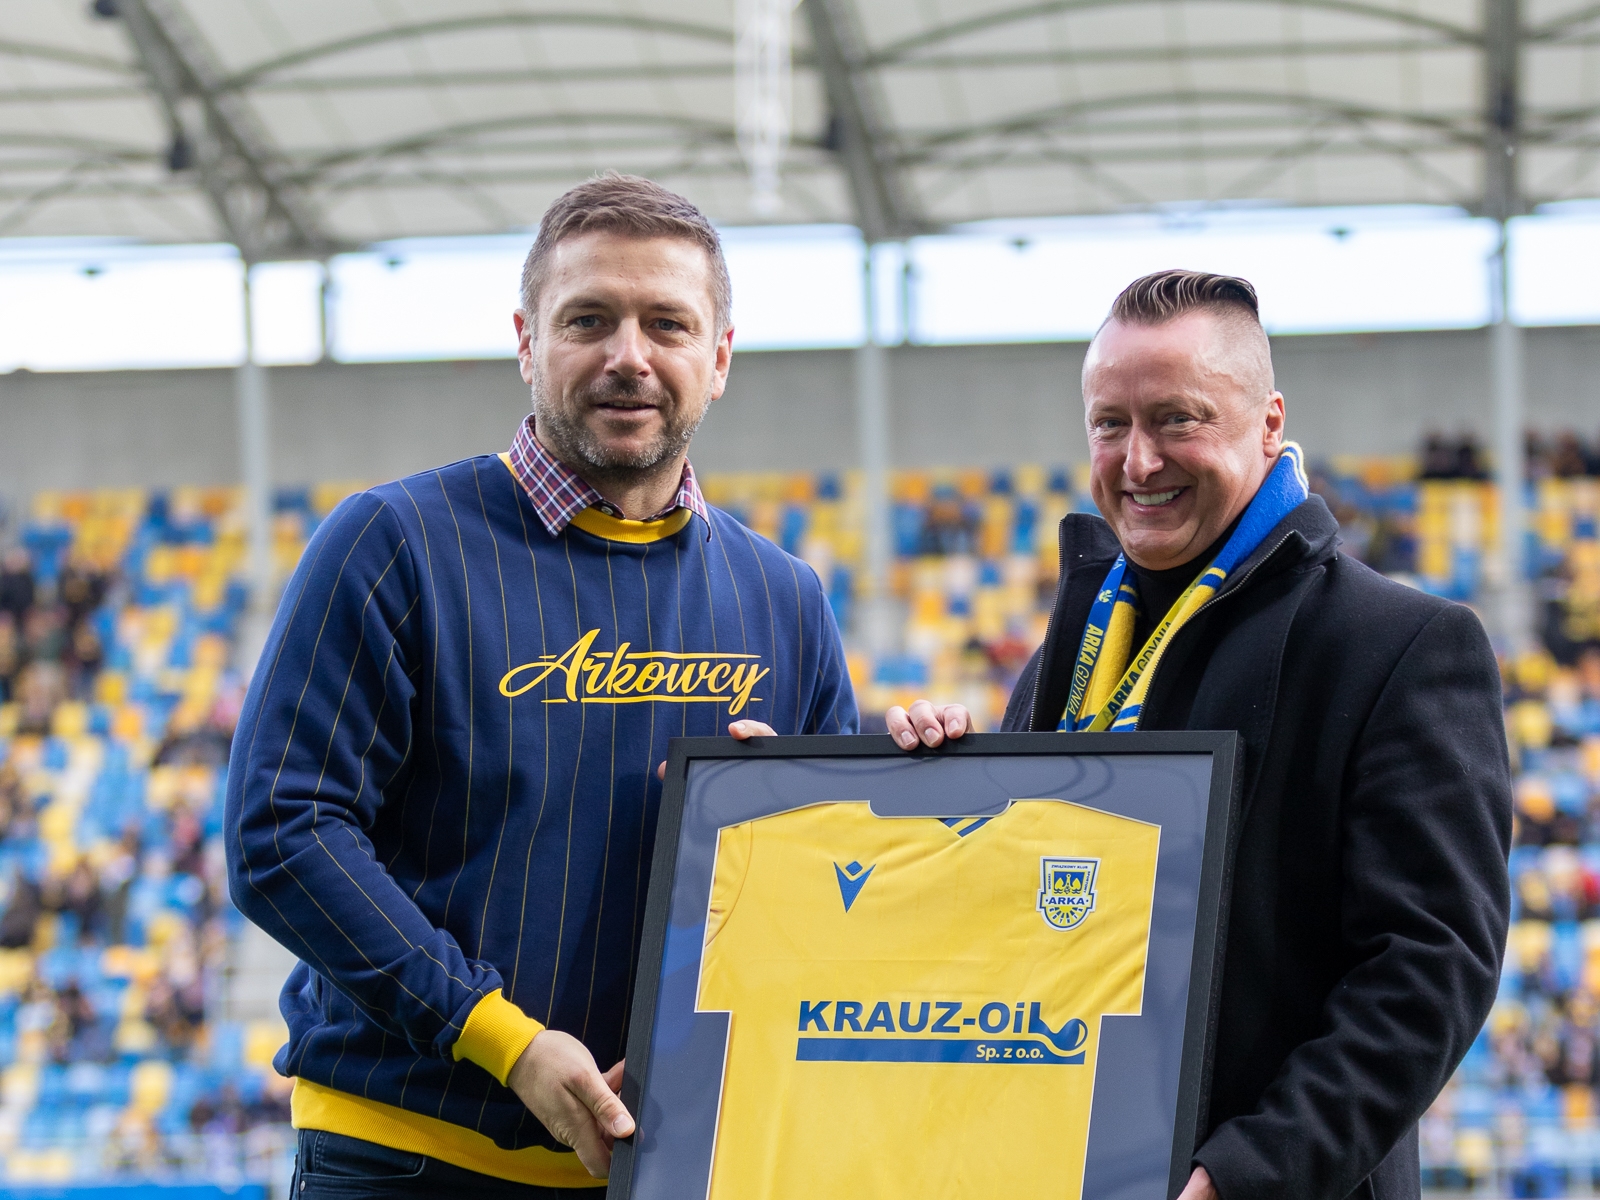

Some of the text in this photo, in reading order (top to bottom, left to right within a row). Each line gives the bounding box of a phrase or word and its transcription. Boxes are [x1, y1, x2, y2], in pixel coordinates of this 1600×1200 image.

[499, 628, 771, 716] Arkowcy
[1068, 623, 1104, 716] ARKA GDYNIA
[1107, 671, 1141, 716] ARKA
[1048, 897, 1085, 905] ARKA
[976, 1044, 1044, 1061] Sp. z o.o.
